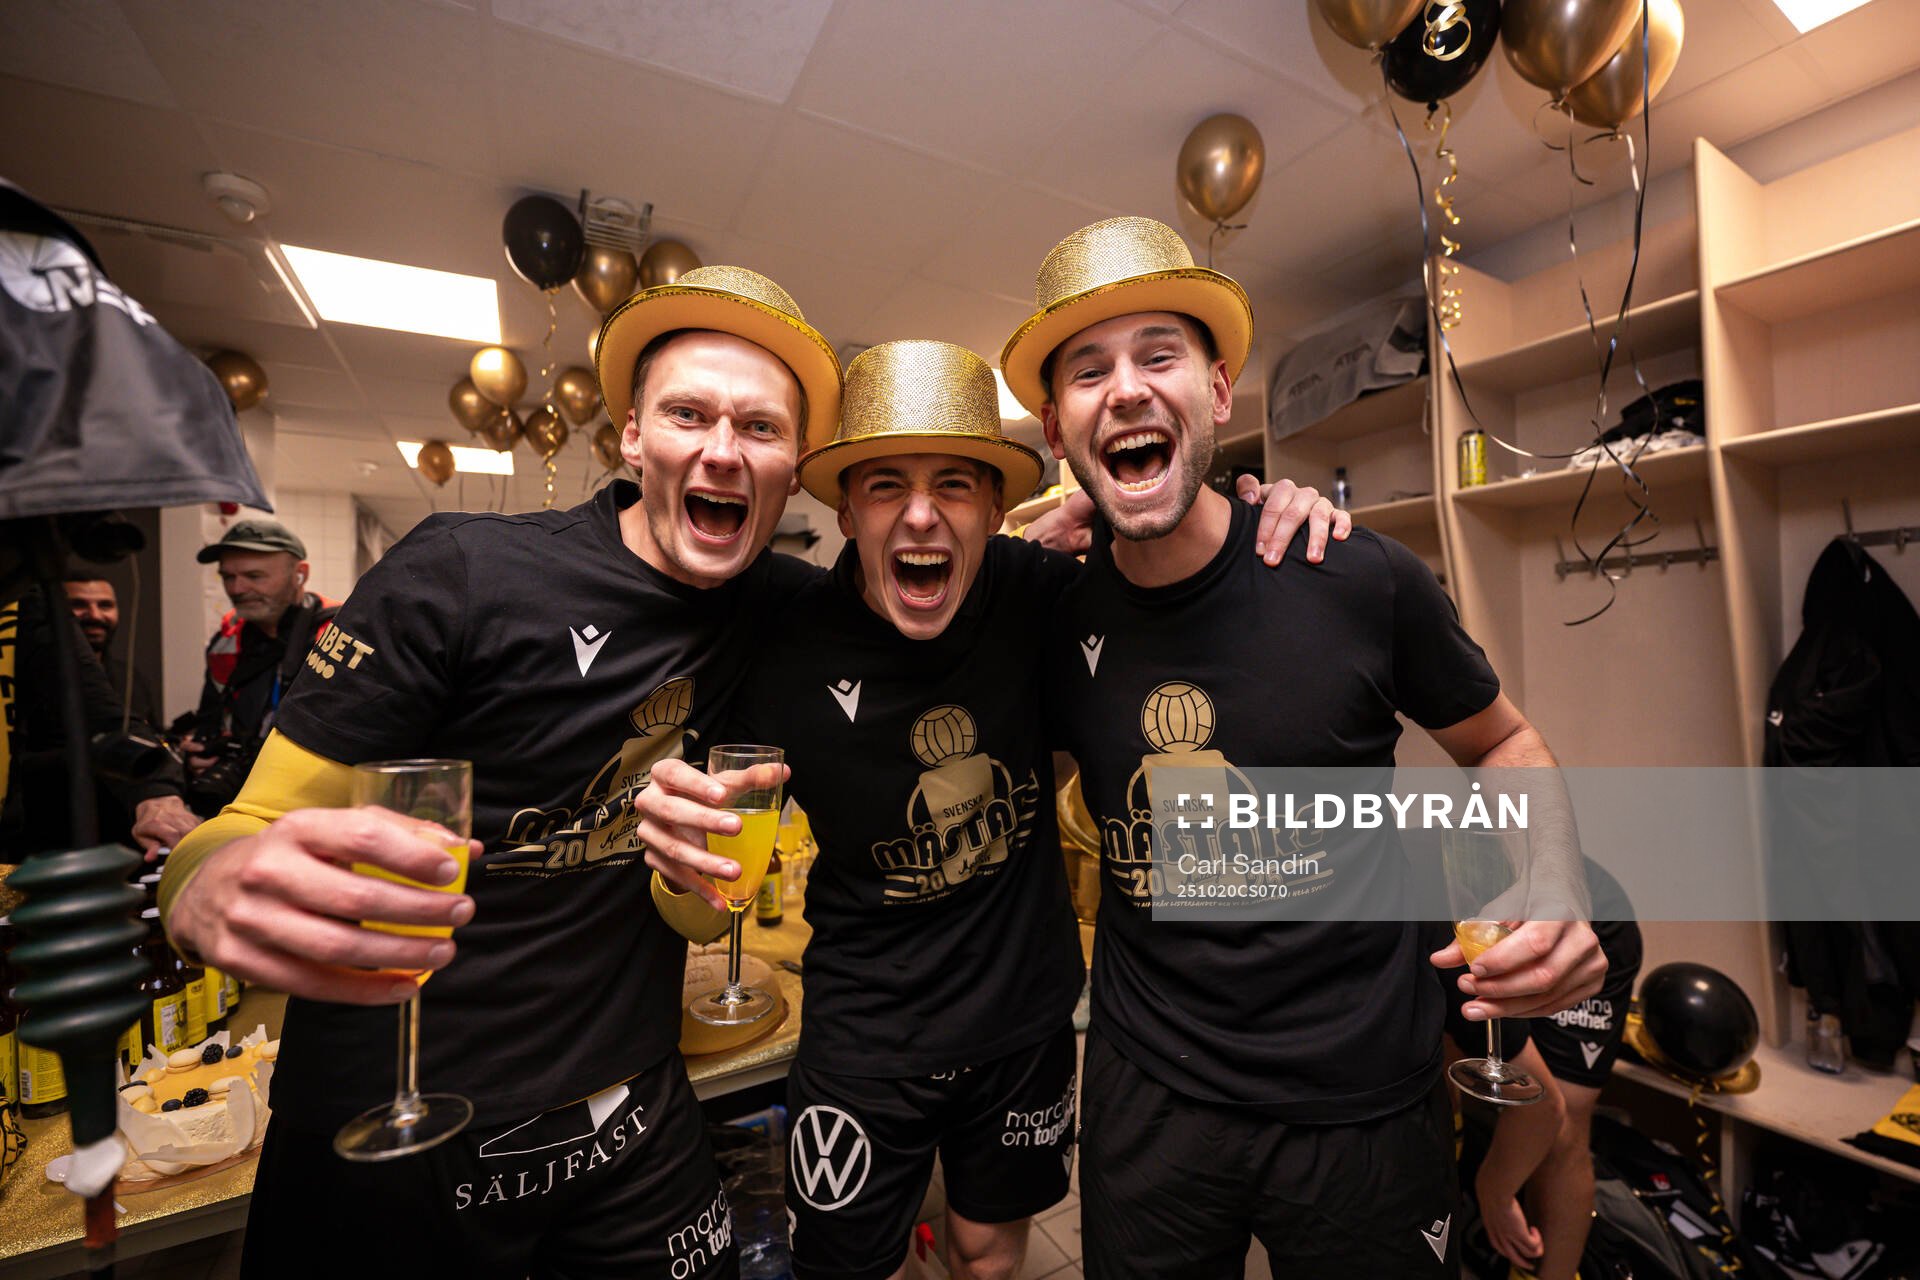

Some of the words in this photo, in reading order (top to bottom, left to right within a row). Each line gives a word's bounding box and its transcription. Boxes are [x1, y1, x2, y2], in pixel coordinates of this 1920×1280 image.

[943, 794, 984, 819] SVENSKA
[545, 840, 586, 869] 20
[915, 870, 946, 896] 20
[1130, 867, 1166, 898] 20
[1001, 1131, 1030, 1147] on
[455, 1105, 648, 1210] SÄLJFAST
[667, 1178, 729, 1257] marc
[671, 1247, 707, 1280] on
